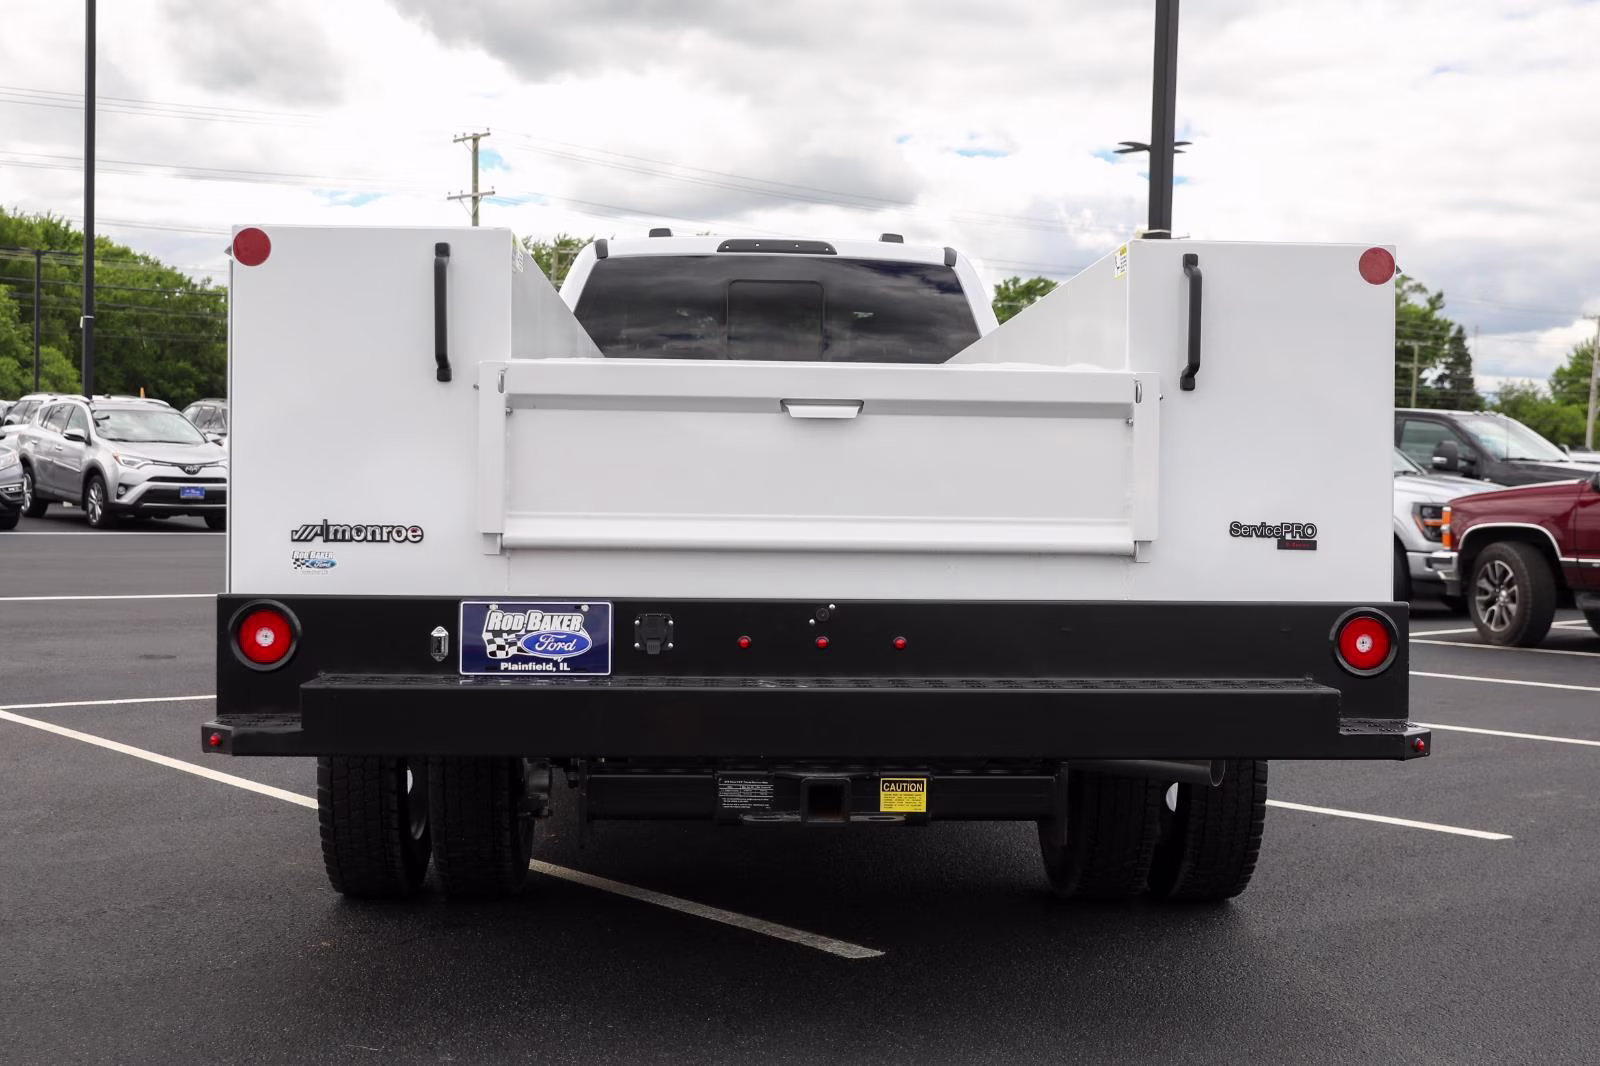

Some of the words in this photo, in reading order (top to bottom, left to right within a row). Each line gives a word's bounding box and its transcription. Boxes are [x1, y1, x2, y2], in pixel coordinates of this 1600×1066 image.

[326, 523, 424, 543] monroe
[1229, 521, 1317, 539] ServicePRO
[487, 611, 526, 631] ROD
[526, 611, 583, 631] BAKER
[535, 634, 577, 651] Ford
[500, 662, 557, 672] Plainfield,
[559, 662, 571, 671] IL
[883, 782, 923, 792] CAUTION
